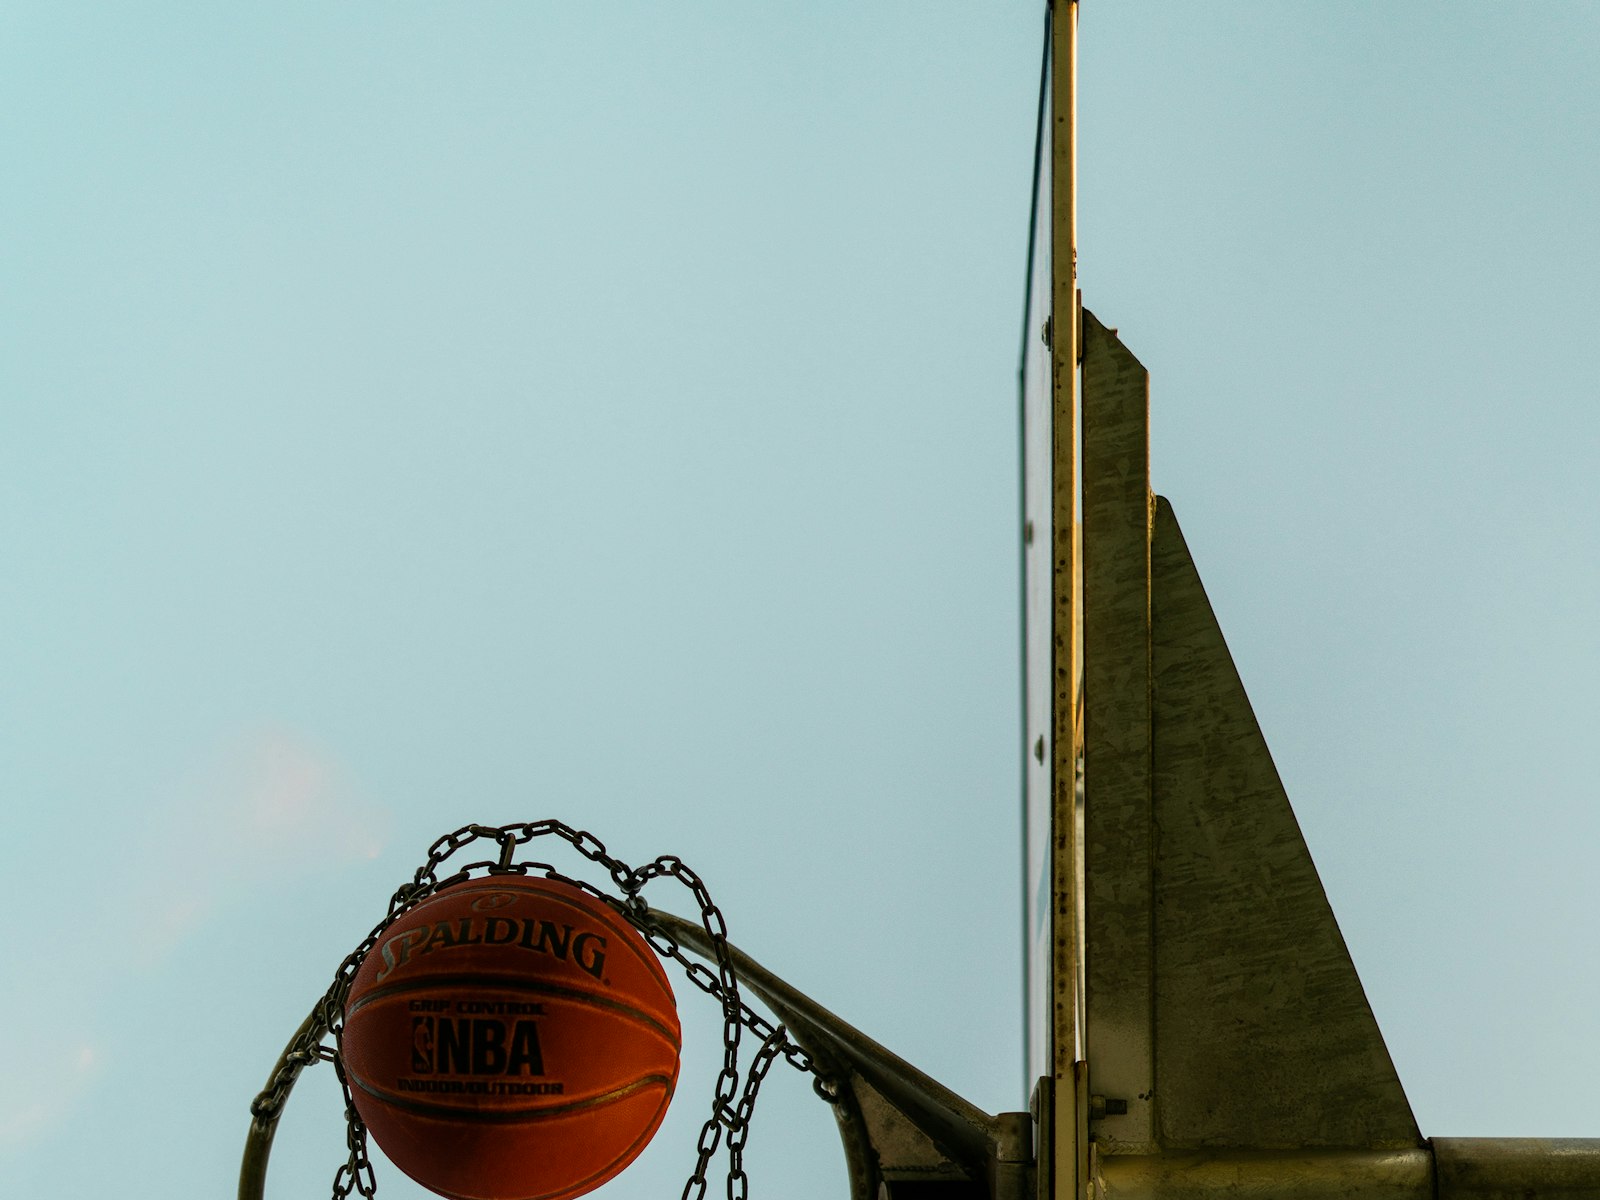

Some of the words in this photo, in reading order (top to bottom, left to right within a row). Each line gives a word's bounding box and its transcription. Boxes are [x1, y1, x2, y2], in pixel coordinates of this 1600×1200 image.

[375, 916, 609, 983] SPALDING
[409, 999, 450, 1012] GRIP
[457, 1001, 548, 1015] CONTROL
[438, 1017, 546, 1076] NBA
